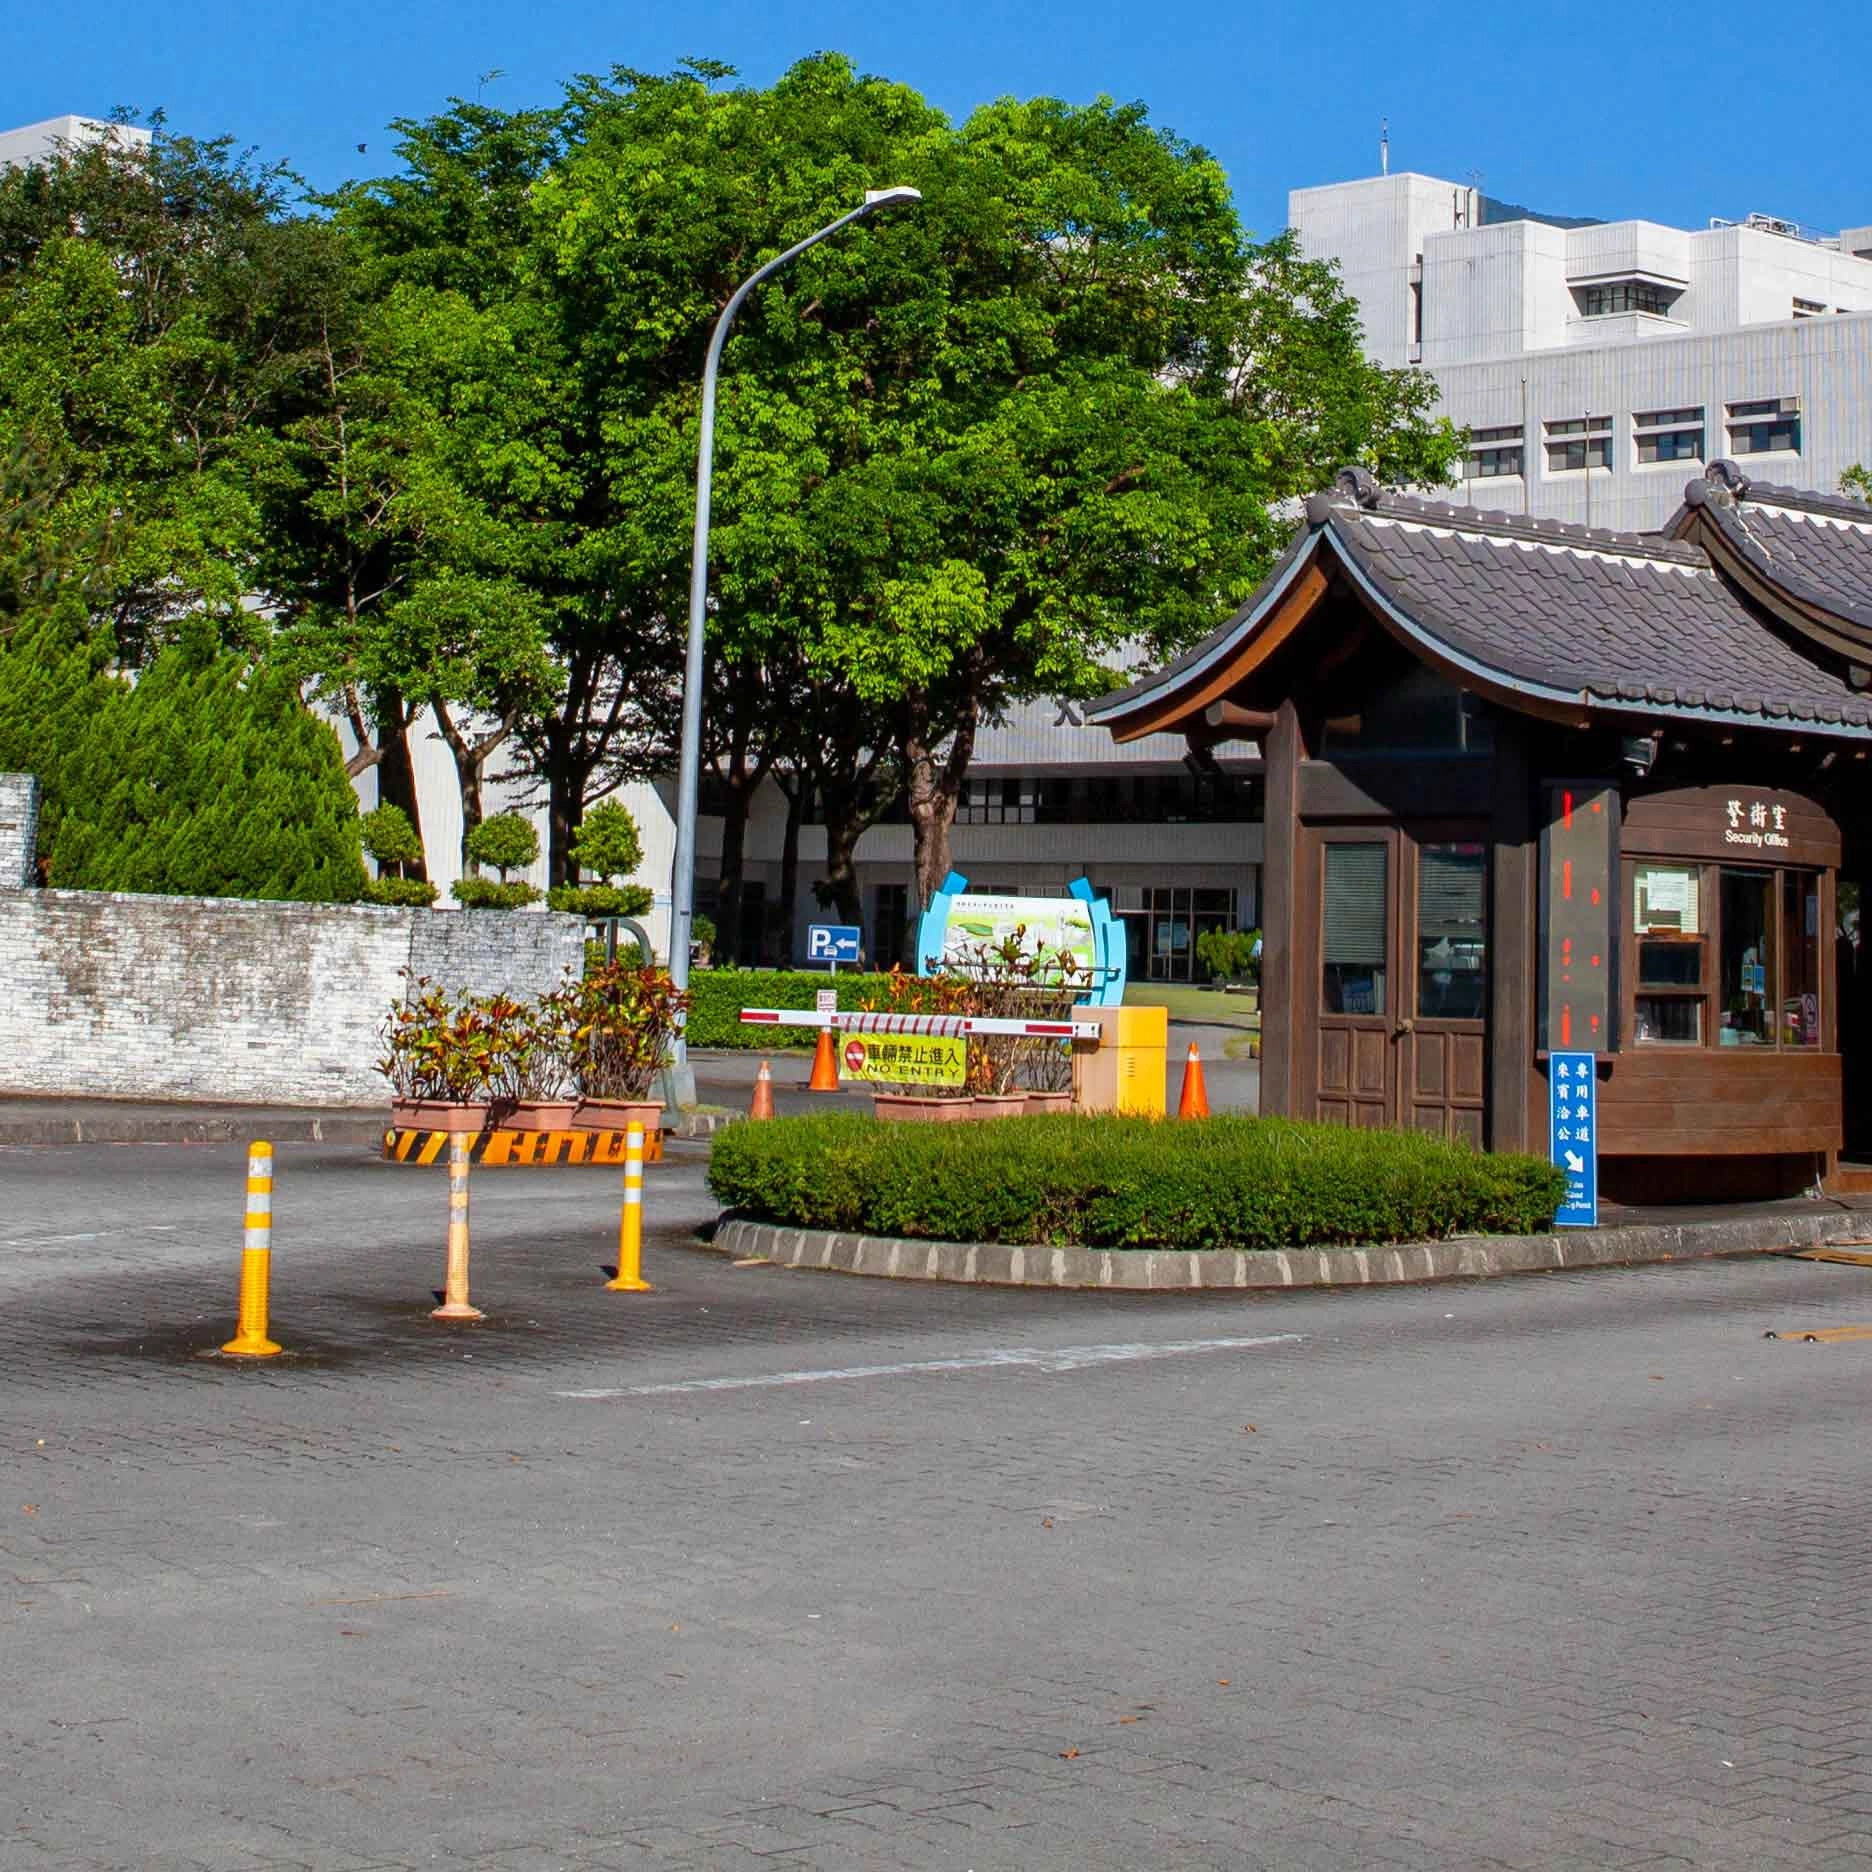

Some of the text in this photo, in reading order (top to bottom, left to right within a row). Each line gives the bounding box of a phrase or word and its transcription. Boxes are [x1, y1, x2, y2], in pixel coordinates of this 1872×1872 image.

[1726, 799, 1788, 830] 警衛室
[1725, 829, 1789, 848] Security Office
[811, 929, 831, 956] P
[867, 1043, 961, 1066] 車輛禁止進入
[866, 1063, 961, 1079] NO ENTRY
[1575, 1061, 1591, 1142] 專用車道
